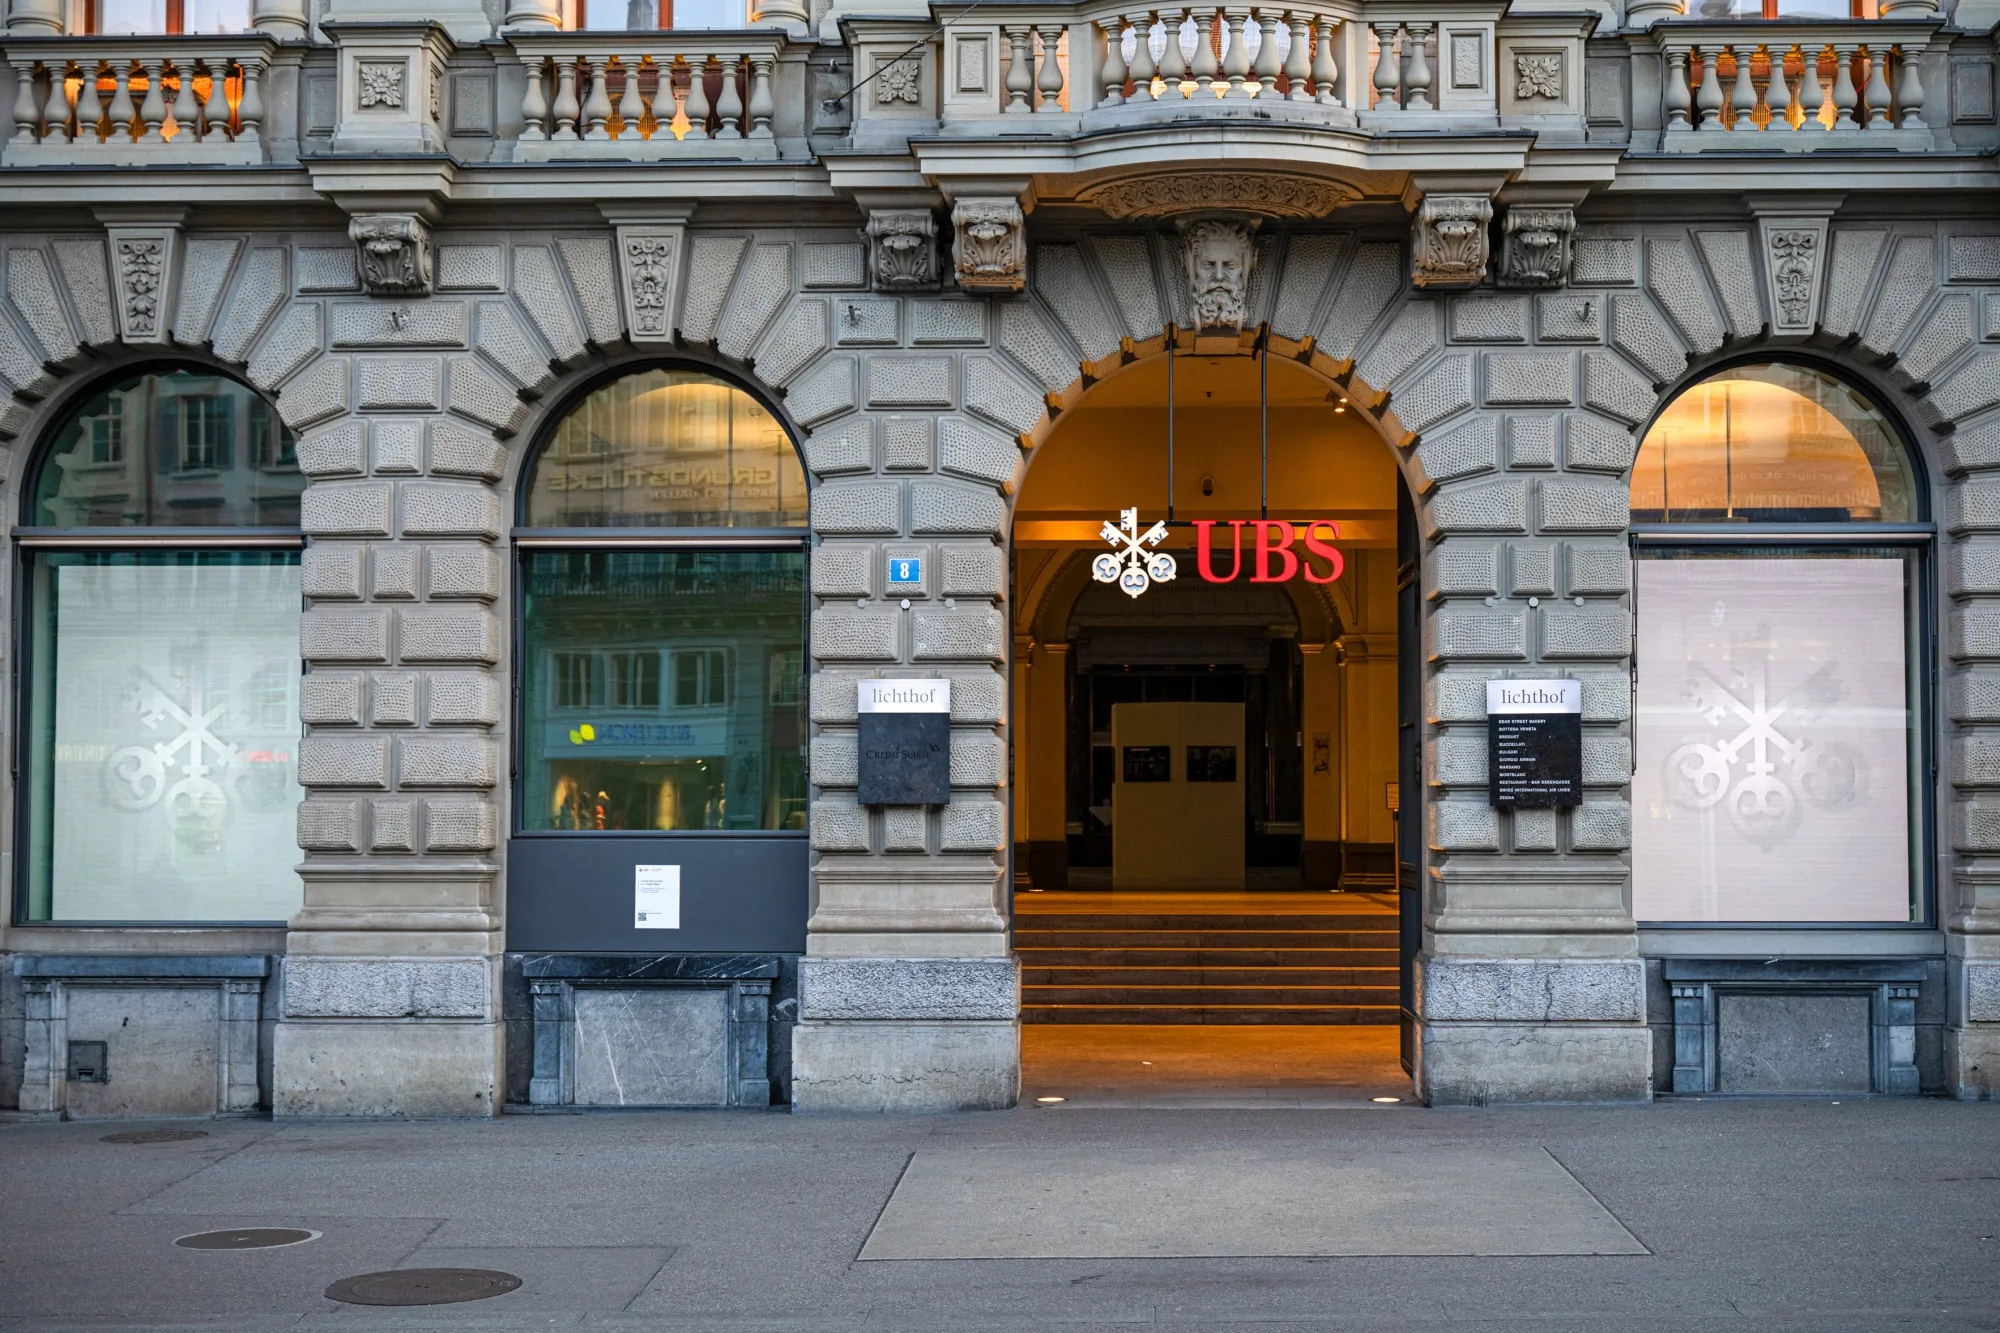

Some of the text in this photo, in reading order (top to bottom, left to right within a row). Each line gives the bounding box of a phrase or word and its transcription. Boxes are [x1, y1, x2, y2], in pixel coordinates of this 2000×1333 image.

[1191, 519, 1345, 584] UBS
[900, 562, 910, 579] 8
[873, 688, 936, 703] lichthof
[1501, 689, 1566, 704] lichthof
[866, 749, 931, 760] CREDIT SUISSE
